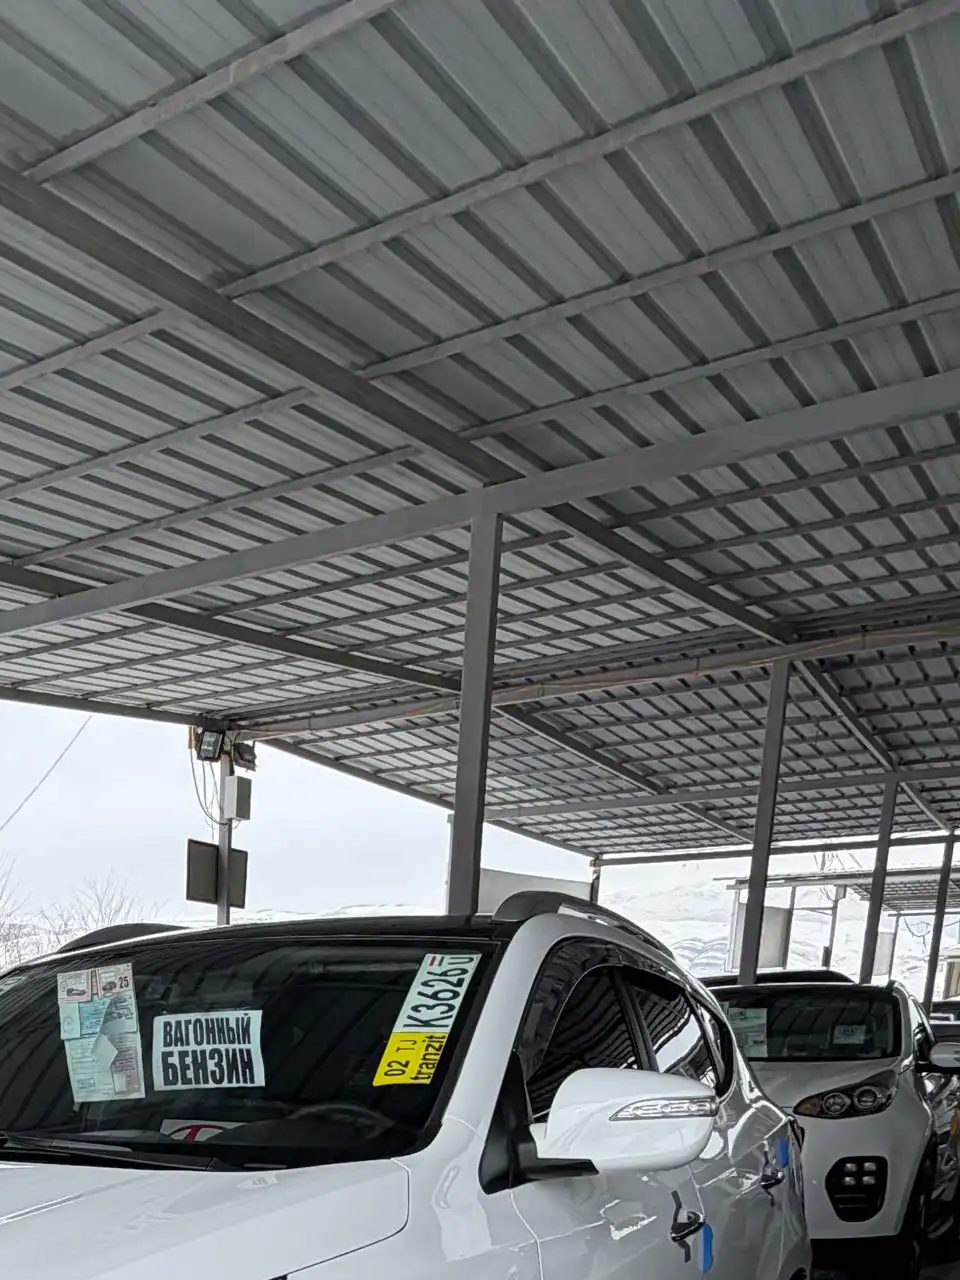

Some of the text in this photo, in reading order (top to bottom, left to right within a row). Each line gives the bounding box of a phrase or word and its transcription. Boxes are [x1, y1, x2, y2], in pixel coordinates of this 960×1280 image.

[163, 1013, 251, 1047] ВАГОННЫЙ
[161, 1048, 255, 1086] БЕНЗИН
[383, 1060, 411, 1077] 02
[409, 1034, 447, 1081] tranzit
